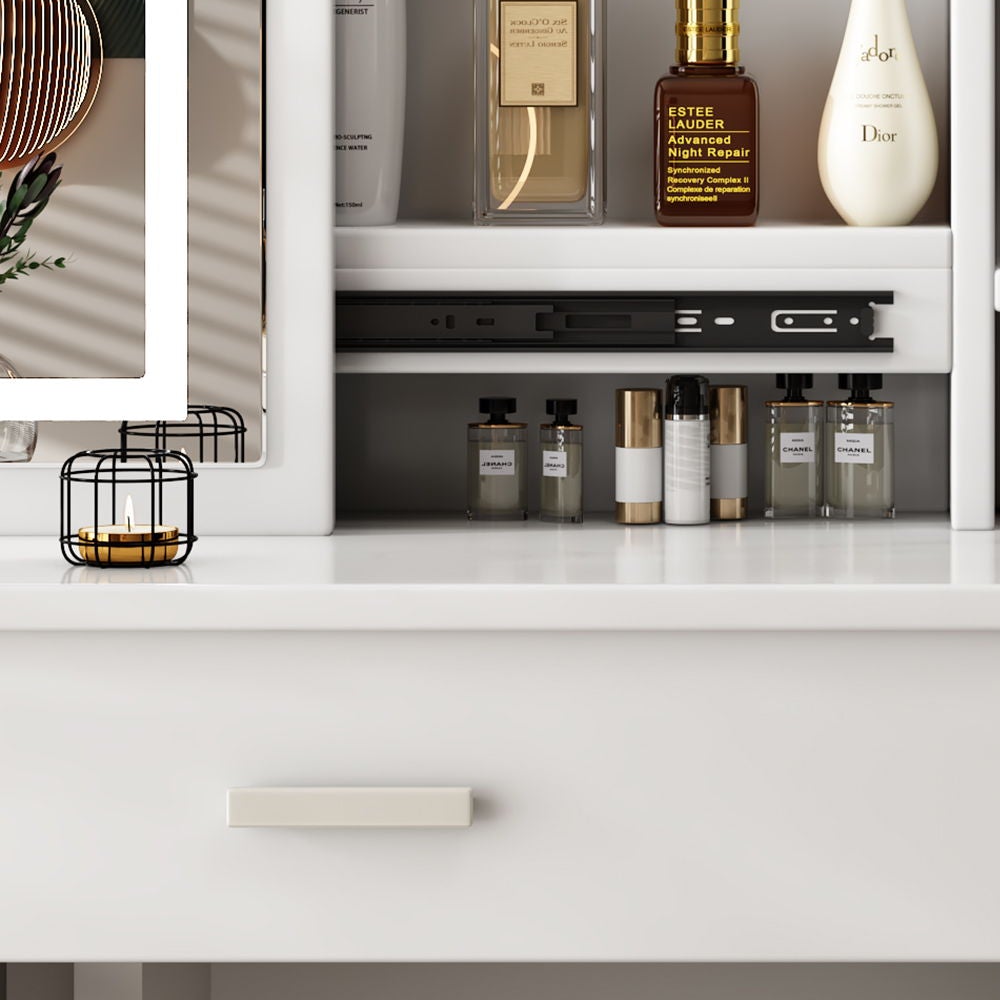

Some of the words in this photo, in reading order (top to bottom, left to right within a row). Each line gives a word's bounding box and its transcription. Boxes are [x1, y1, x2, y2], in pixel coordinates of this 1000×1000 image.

[668, 106, 714, 117] ESTEE
[668, 119, 725, 129] LAUDER
[861, 124, 898, 143] Dior
[667, 135, 731, 145] Advanced
[668, 147, 702, 159] Night
[707, 147, 750, 159] Repair
[667, 167, 721, 175] Synchronized
[704, 185, 714, 193] de
